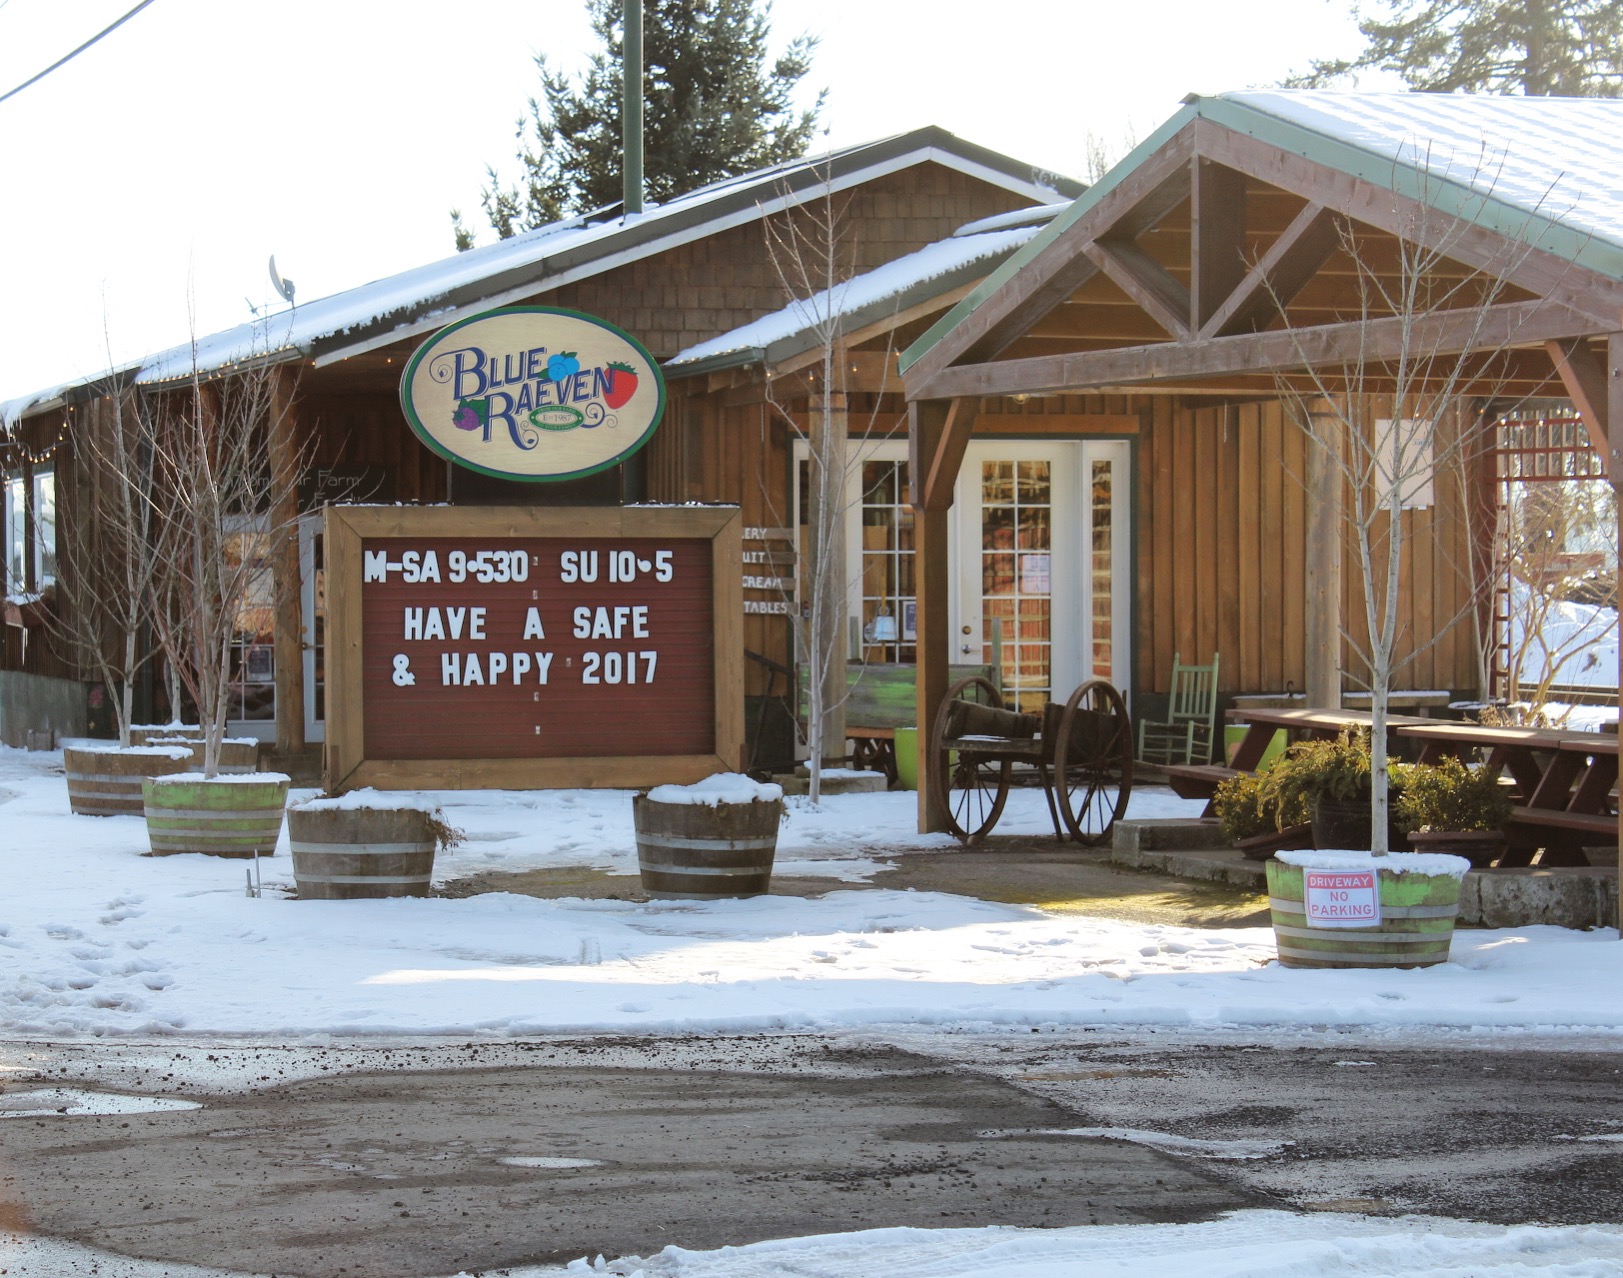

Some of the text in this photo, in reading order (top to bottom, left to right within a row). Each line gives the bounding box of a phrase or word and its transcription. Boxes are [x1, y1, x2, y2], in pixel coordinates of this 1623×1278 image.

[429, 347, 547, 401] BLUE
[482, 367, 617, 450] RAEVEN
[318, 469, 361, 487] Farm
[560, 550, 599, 583] SU
[404, 606, 650, 640] HAVE A SAFE
[392, 651, 658, 687] & HAPPY 2017
[1309, 876, 1370, 888] DRIVEWAY
[1329, 891, 1349, 902] NO
[1311, 904, 1372, 916] PARKING
